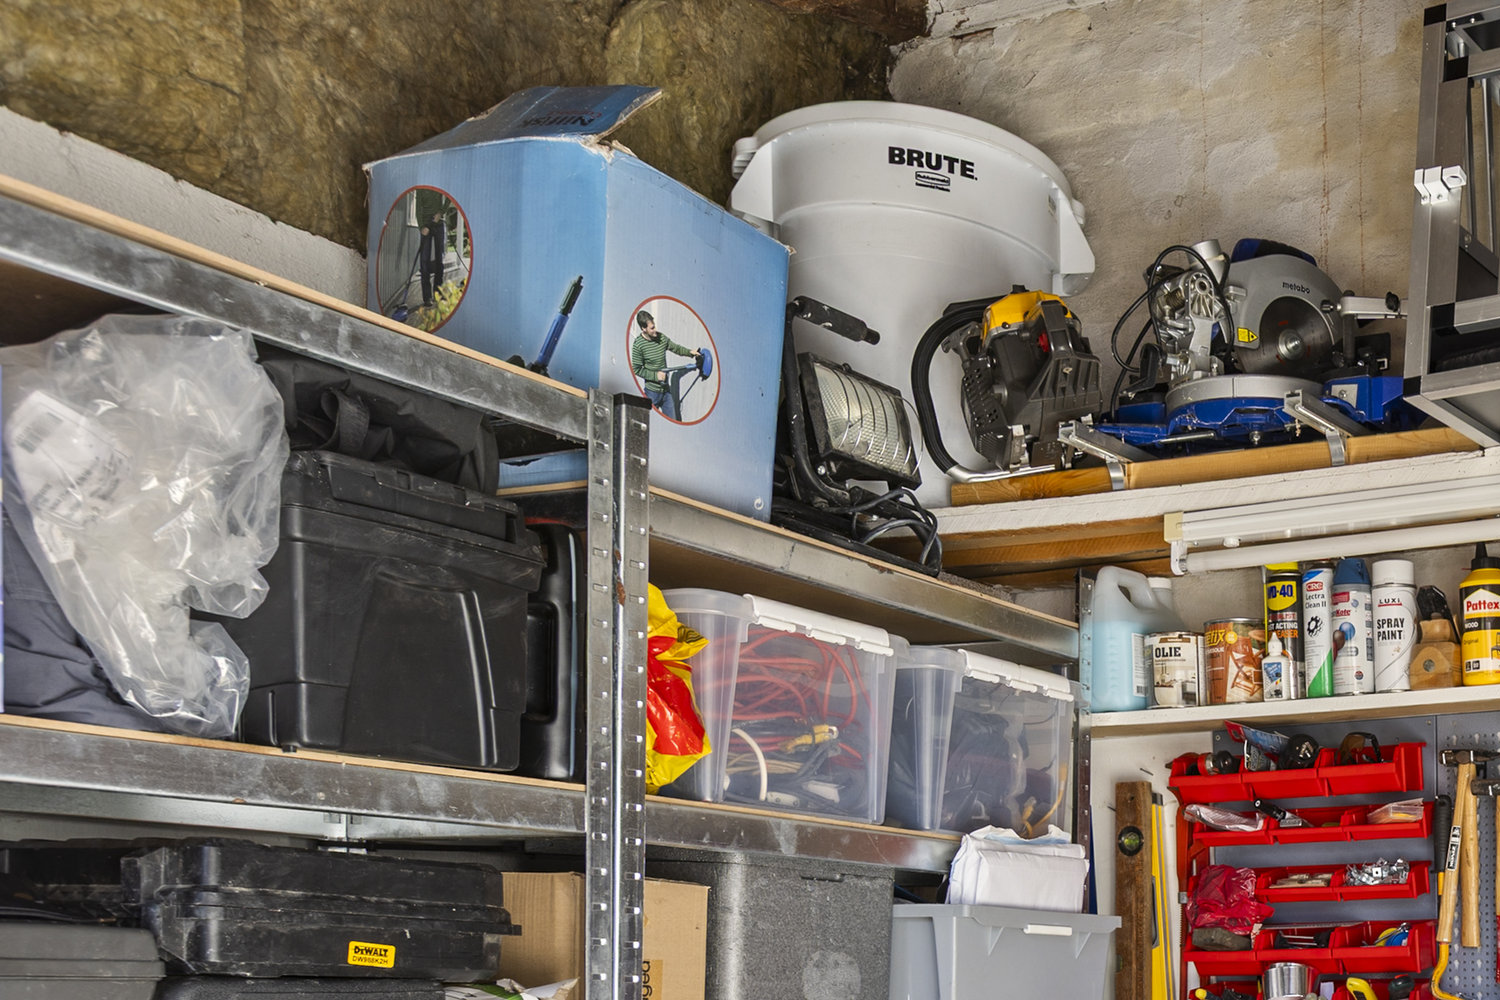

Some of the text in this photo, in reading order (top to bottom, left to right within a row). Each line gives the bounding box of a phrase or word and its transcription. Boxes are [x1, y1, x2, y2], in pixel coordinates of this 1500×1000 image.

[1282, 282, 1310, 294] metabo
[1306, 582, 1323, 591] CRC
[1466, 600, 1500, 612] Pattex
[1275, 622, 1298, 630] ACTING
[1377, 618, 1405, 630] SPRAY
[1377, 630, 1403, 641] PAINT
[1155, 646, 1181, 658] OLIE
